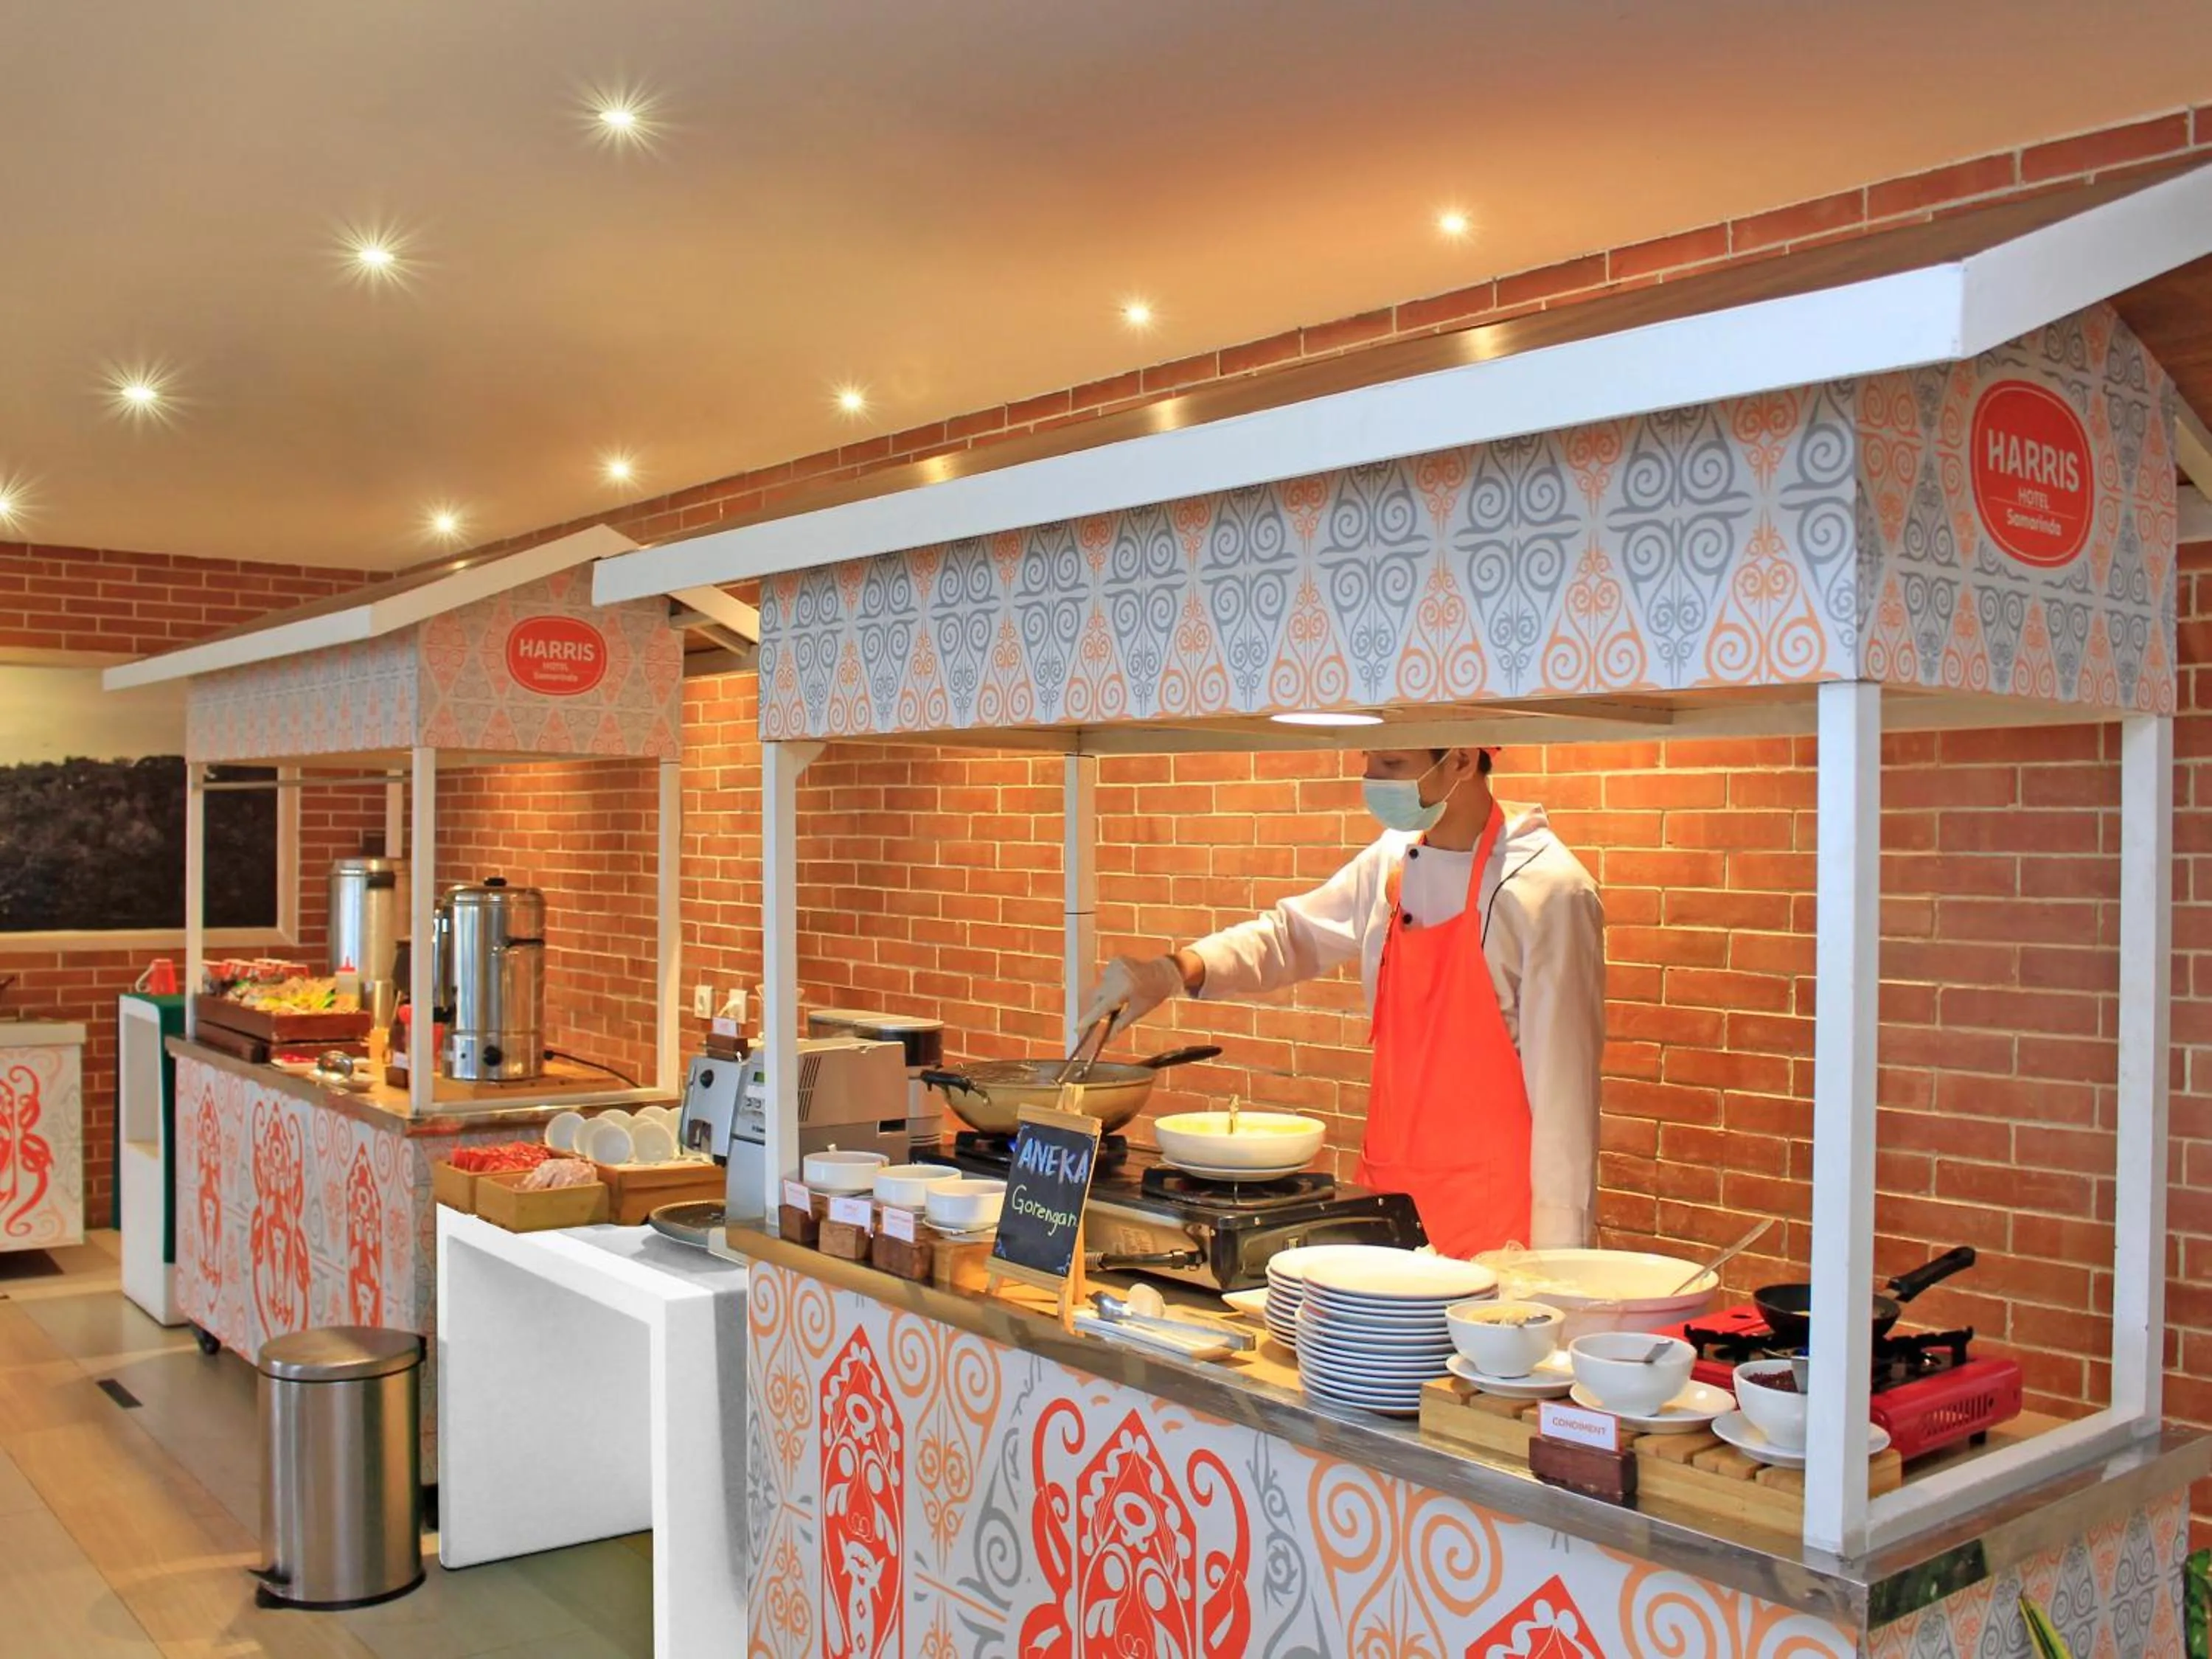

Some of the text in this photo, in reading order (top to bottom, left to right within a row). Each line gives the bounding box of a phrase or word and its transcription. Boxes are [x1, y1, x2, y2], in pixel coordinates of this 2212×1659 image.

[1987, 428, 2080, 493] HARRIS
[2017, 487, 2050, 510] HOTEL
[519, 638, 595, 661] HARRIS
[1017, 1138, 1089, 1184] ANEKA
[1011, 1184, 1077, 1237] Gorengan
